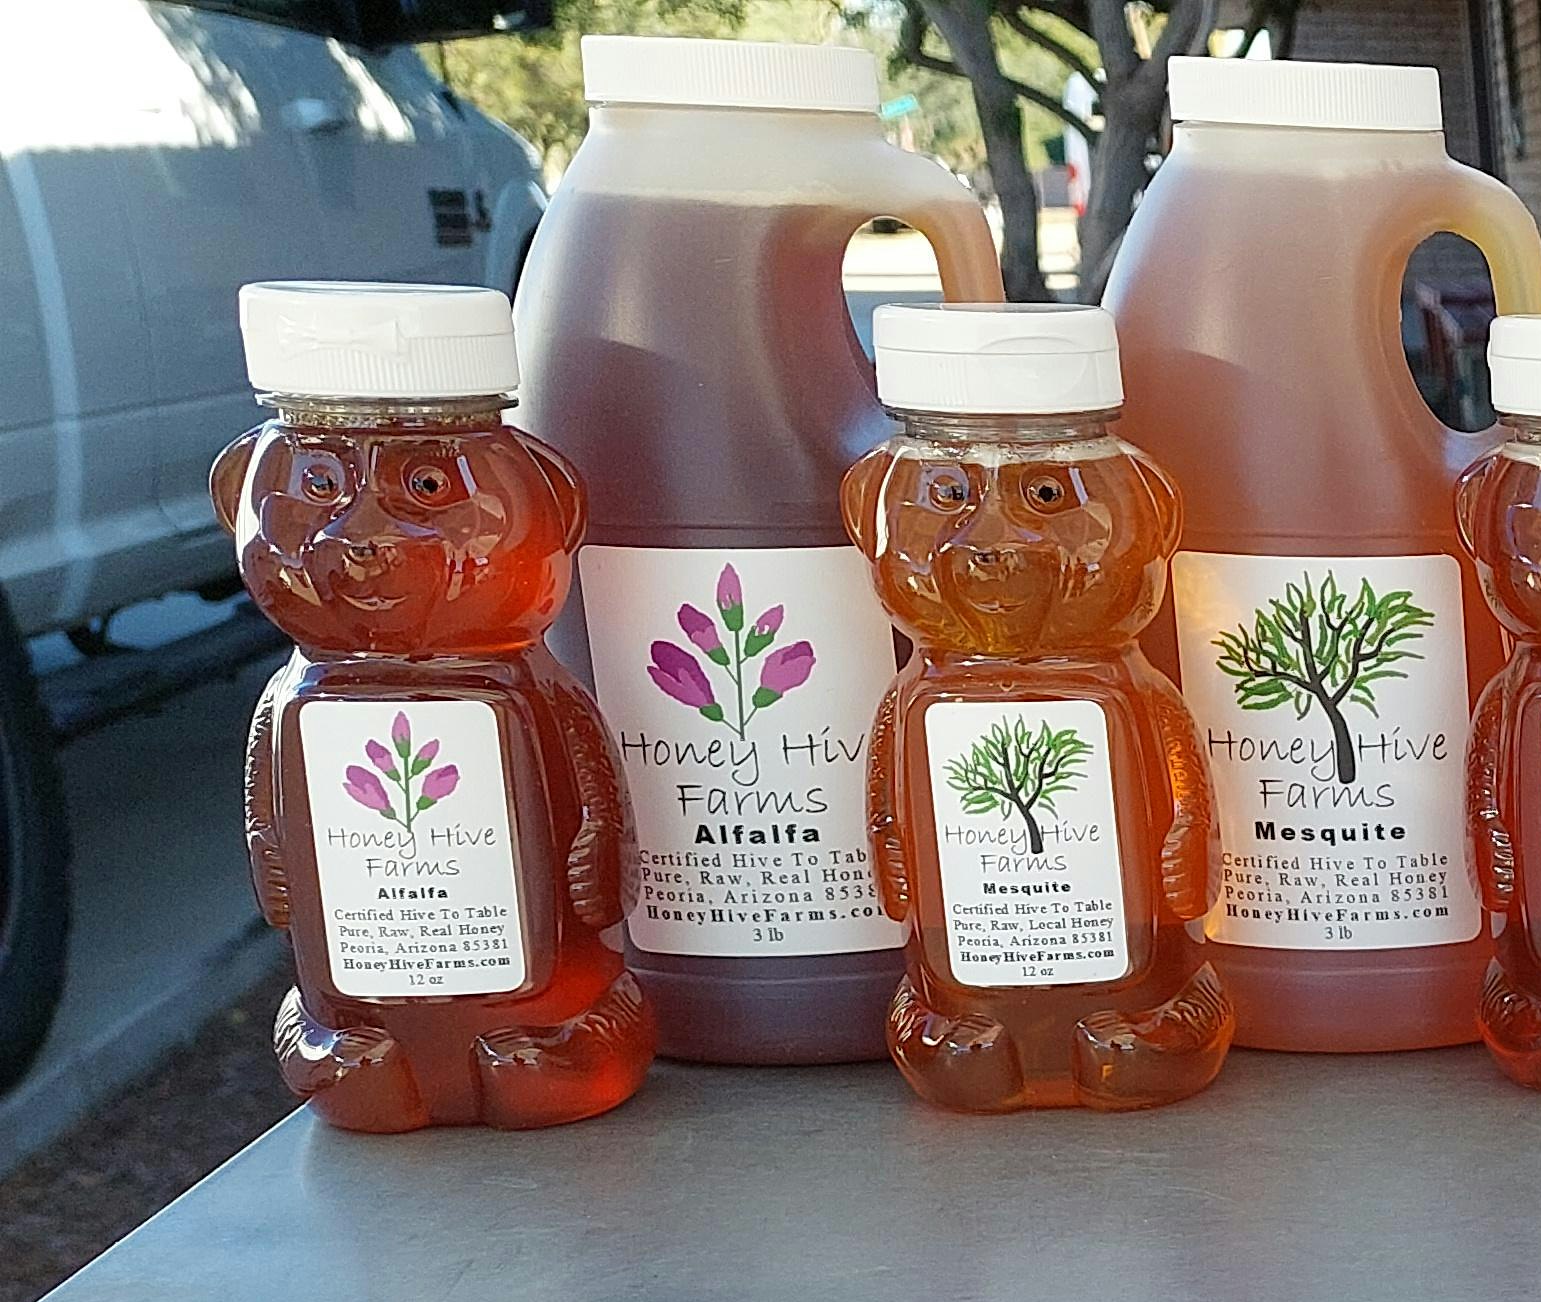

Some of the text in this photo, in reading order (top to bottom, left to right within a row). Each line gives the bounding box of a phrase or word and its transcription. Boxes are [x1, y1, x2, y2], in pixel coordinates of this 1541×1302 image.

[621, 726, 865, 786] Honey Hiv
[1208, 727, 1448, 781] Honey Hive
[677, 785, 828, 815] Farms
[1259, 779, 1395, 808] Farms
[328, 824, 496, 859] Honey Hive
[695, 825, 820, 844] Alfalfa
[945, 821, 1100, 855] Honey Hive
[1256, 822, 1406, 846] Mesquite
[366, 858, 460, 877] Farms
[981, 855, 1067, 872] Farms
[1223, 853, 1448, 870] Certified Hive To Table
[378, 887, 448, 899] Alfalfa
[645, 885, 876, 904] Peoria, Arizona 853
[984, 882, 1071, 895] Mesquite
[334, 906, 507, 921] Certified Hive To Table
[953, 917, 1113, 932] Pure, Raw, Local Honey
[1325, 926, 1352, 939] 3 lb
[753, 928, 784, 941] 3 lb
[343, 957, 510, 972] HoneyHiveFarms.com
[409, 975, 424, 985] 12
